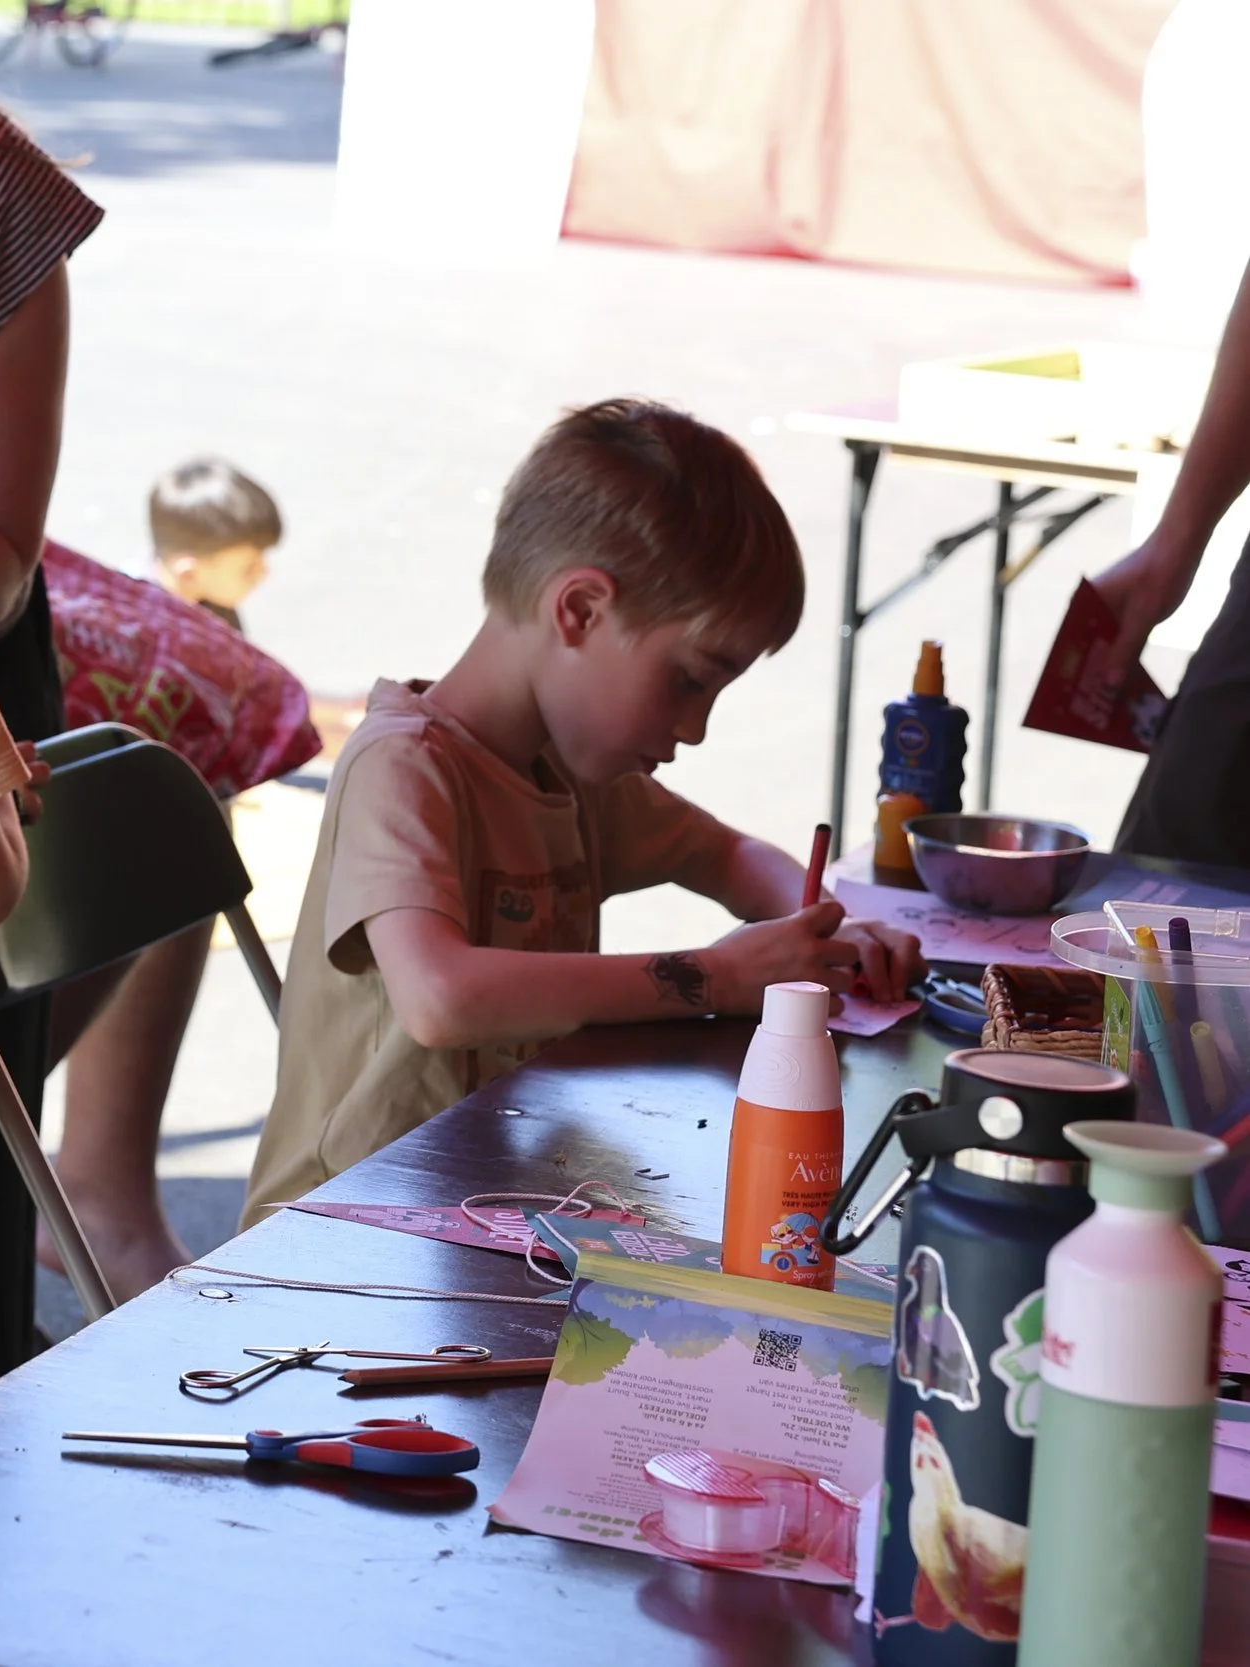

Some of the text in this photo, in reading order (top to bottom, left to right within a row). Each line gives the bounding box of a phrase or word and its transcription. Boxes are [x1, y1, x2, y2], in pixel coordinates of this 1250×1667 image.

[788, 1152, 809, 1160] EAU
[790, 1161, 841, 1182] Avèn
[639, 1375, 657, 1383] voor
[622, 1381, 682, 1398] kinderanimatie
[658, 1379, 714, 1394] voorstellingen
[746, 1385, 770, 1397] hangt
[776, 1381, 817, 1396] prestaties
[840, 1383, 859, 1393] onze
[772, 1391, 788, 1399] rest
[790, 1395, 802, 1403] De
[818, 1390, 829, 1398] de
[831, 1393, 846, 1401] van
[676, 1402, 690, 1410] live
[692, 1404, 709, 1414] Met
[772, 1401, 786, 1410] het
[638, 1403, 707, 1422] BOELAERFEEST
[797, 1407, 828, 1418] scherm
[830, 1412, 853, 1423] Groot
[781, 1422, 796, 1430] 21u
[792, 1414, 851, 1432] WK VOETBAL
[784, 1432, 800, 1440] 21u
